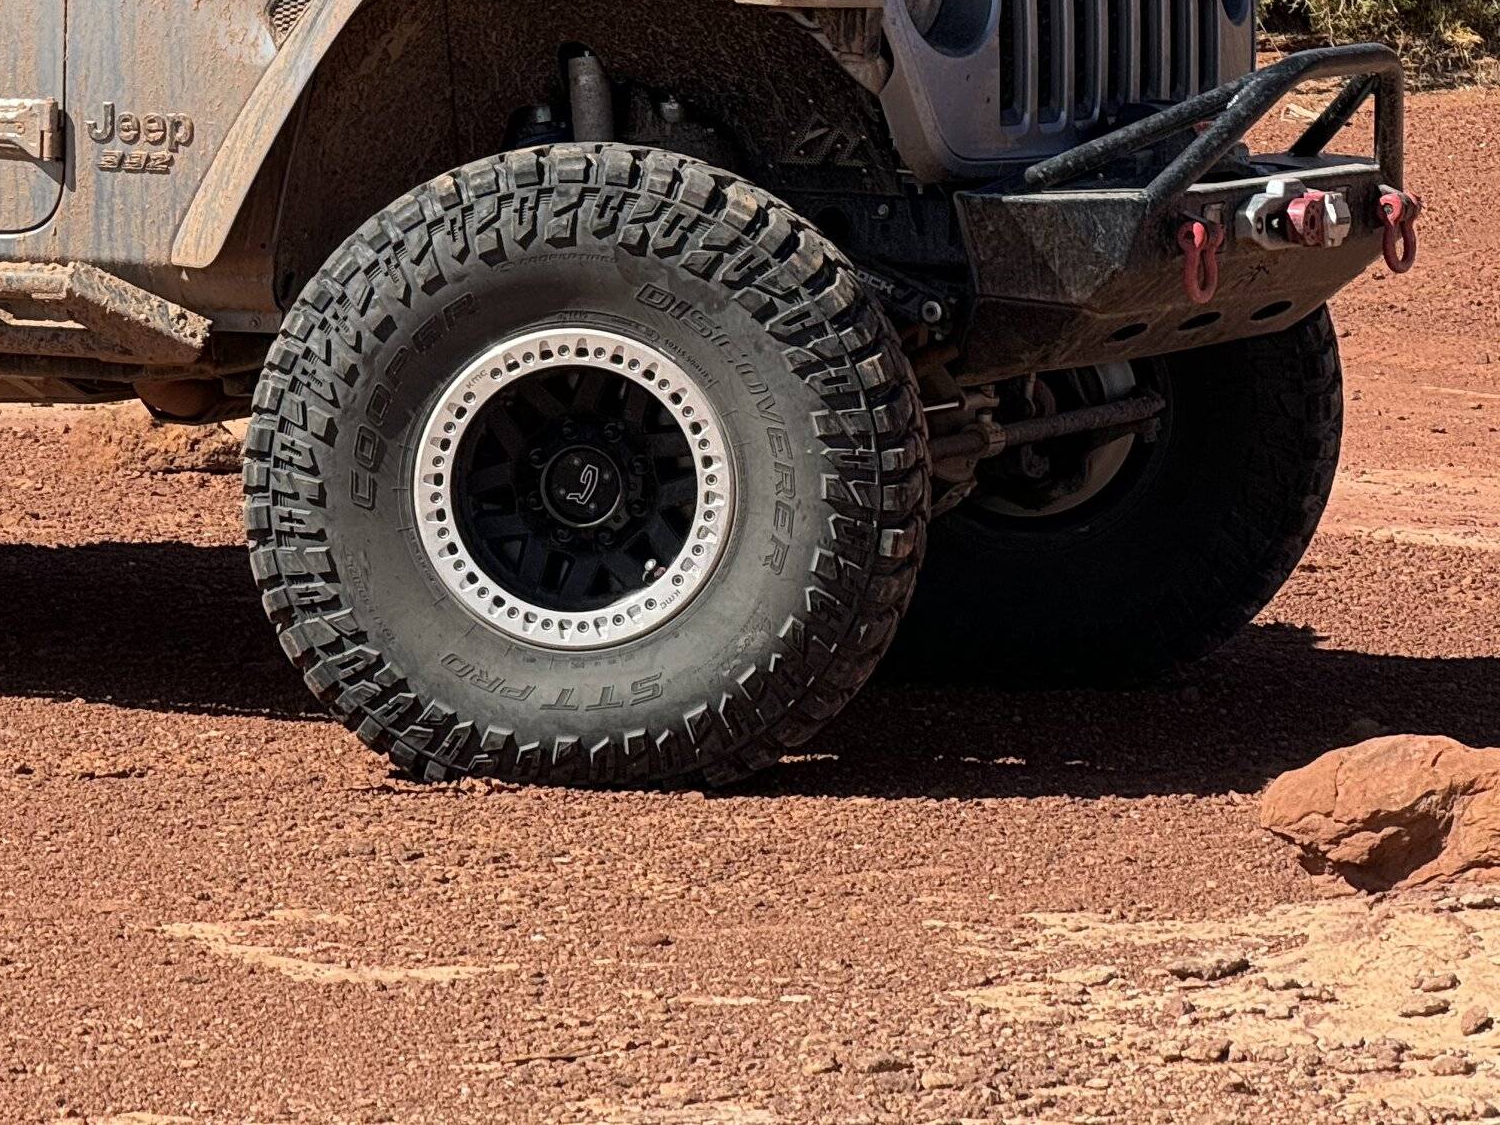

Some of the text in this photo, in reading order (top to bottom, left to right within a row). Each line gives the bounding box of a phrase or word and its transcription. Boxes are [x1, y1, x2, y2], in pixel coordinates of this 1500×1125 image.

[85, 101, 194, 153] Jeep
[350, 292, 476, 510] COOPER
[635, 282, 796, 576] DISCOVERER
[440, 653, 537, 702] PRO
[540, 672, 664, 712] STT
